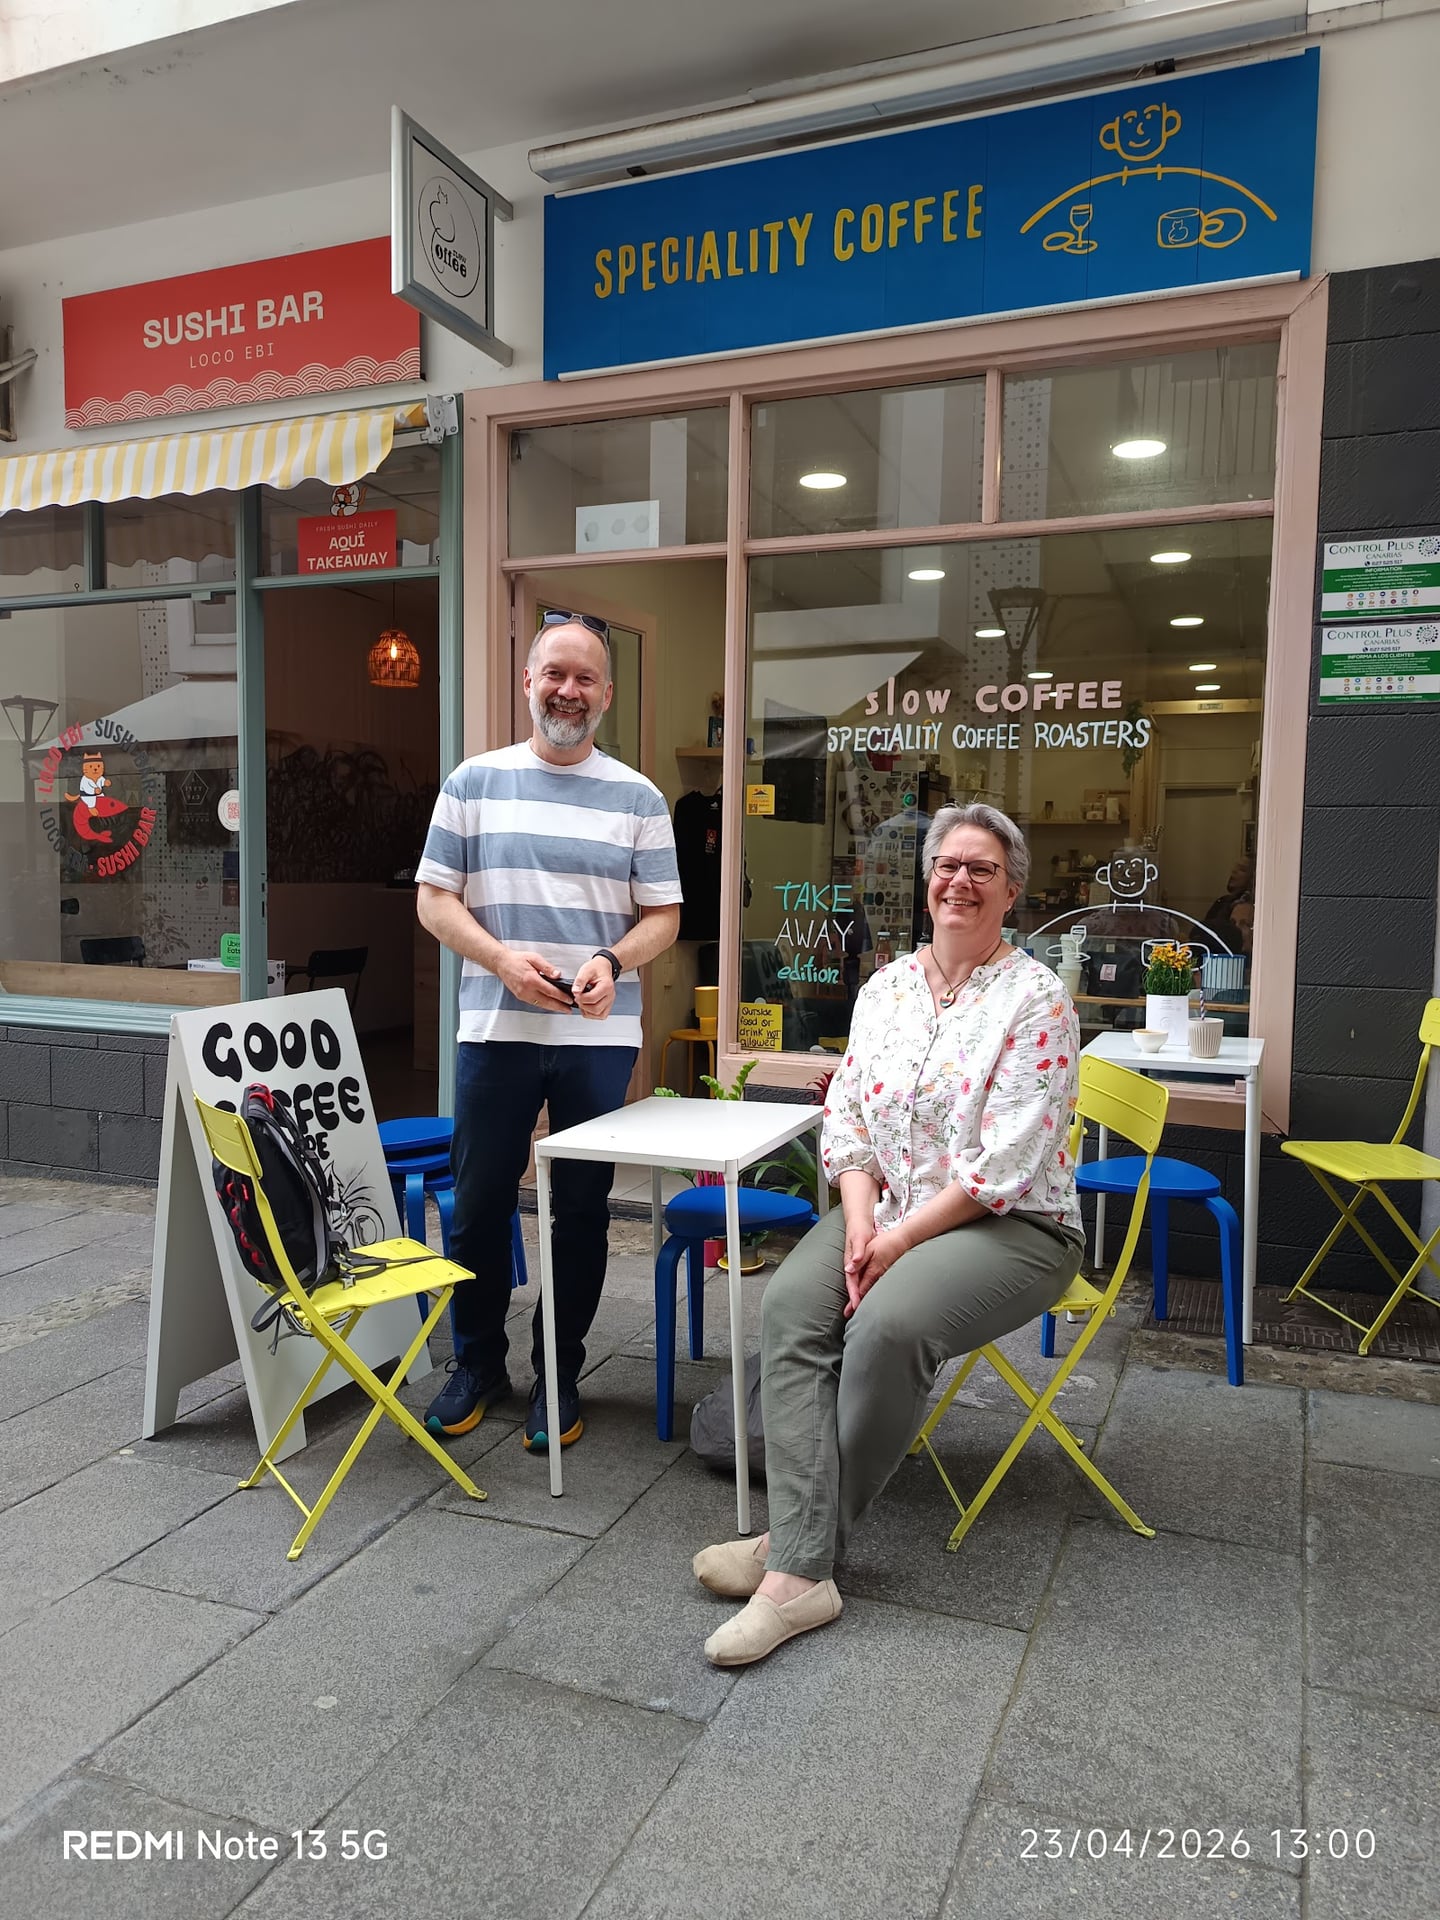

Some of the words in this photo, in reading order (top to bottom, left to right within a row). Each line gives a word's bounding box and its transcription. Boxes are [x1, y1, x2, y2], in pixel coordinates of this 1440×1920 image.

[595, 212, 814, 299] SPECIALITY
[833, 184, 983, 261] COFFEE
[143, 303, 246, 349] SUSHI
[257, 290, 325, 329] BAR
[189, 349, 235, 369] LOCO
[245, 342, 275, 360] EBI
[359, 521, 378, 529] DAILY
[329, 531, 365, 552] AQUÍ
[1366, 552, 1402, 560] CANARIAS
[307, 551, 388, 570] TAKEAWAY
[865, 677, 951, 717] slow
[975, 680, 1123, 712] COFFEE
[58, 722, 84, 751] EBI
[827, 721, 943, 753] SPECIALITY
[952, 723, 1020, 750] COFFEE
[1035, 718, 1151, 749] ROASTERS
[97, 840, 140, 877] SUSHI
[132, 807, 158, 847] BAR
[774, 881, 854, 913] TAKE
[774, 918, 854, 950] AWAY
[776, 956, 839, 985] edition
[739, 1028, 763, 1036] drink
[740, 1038, 775, 1047] allowed
[202, 1019, 341, 1082] GOOD
